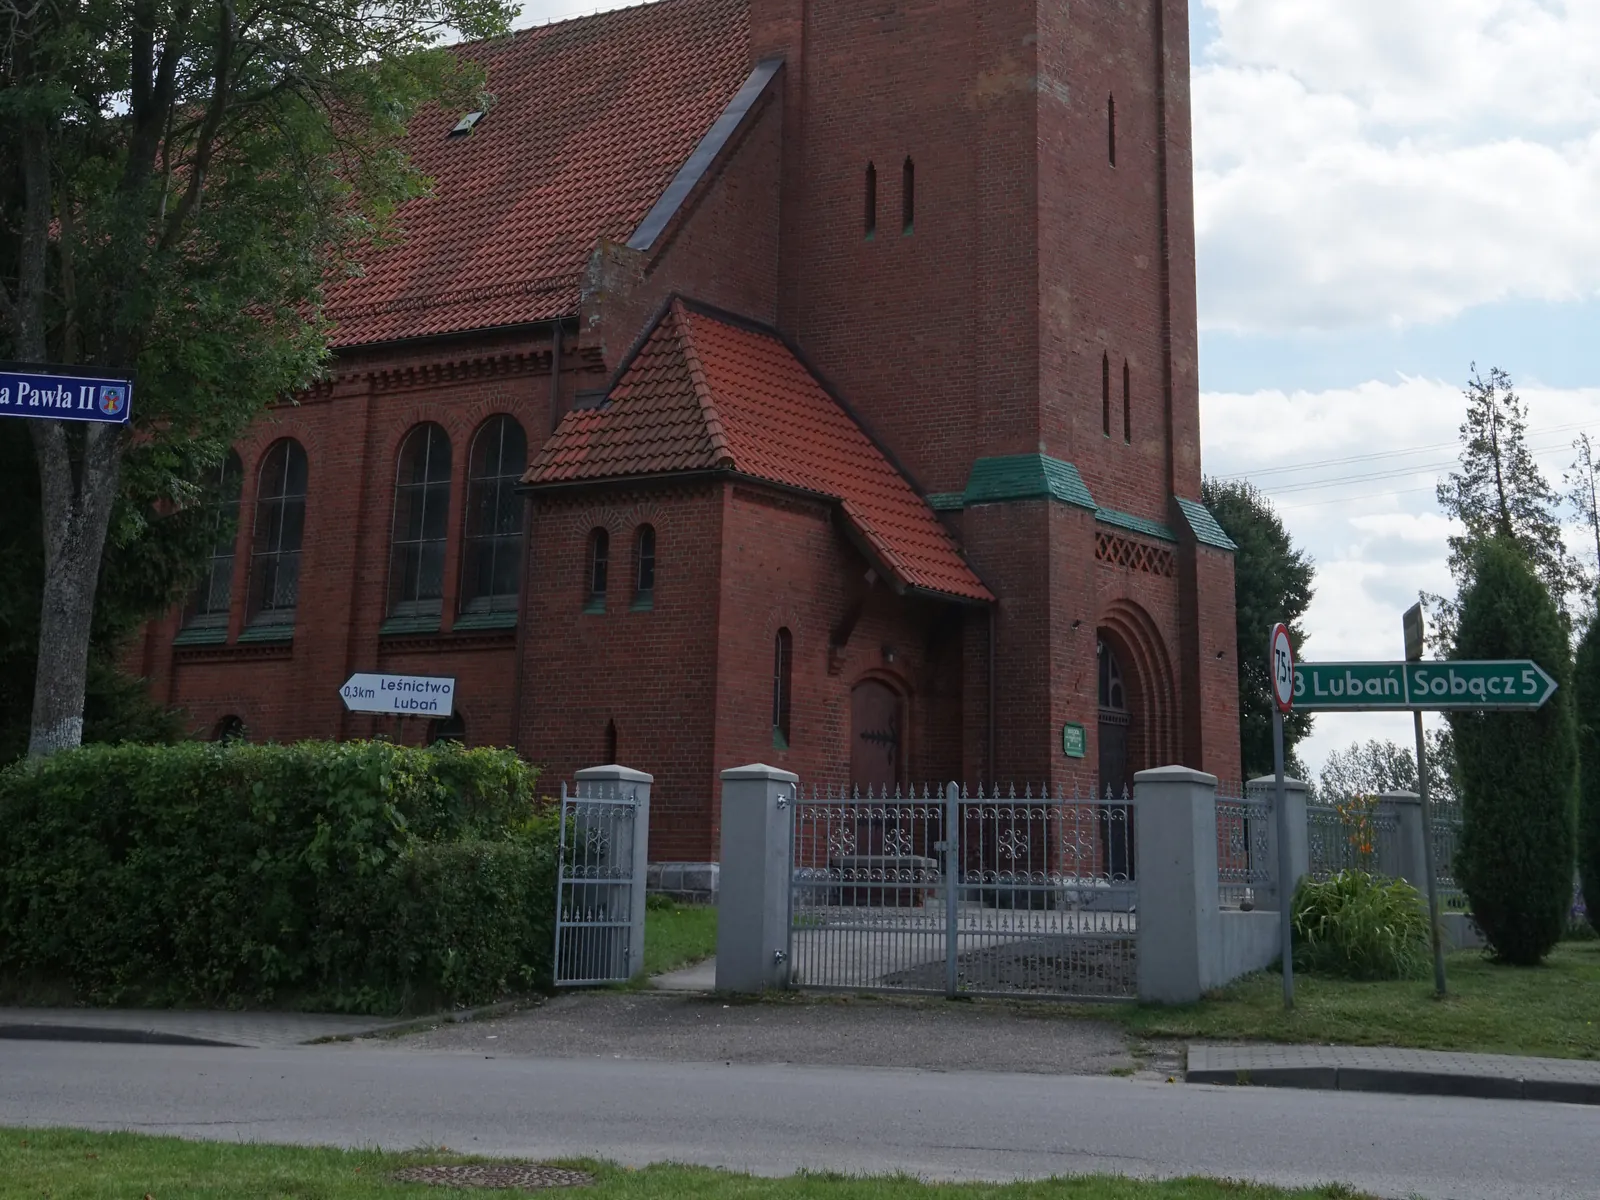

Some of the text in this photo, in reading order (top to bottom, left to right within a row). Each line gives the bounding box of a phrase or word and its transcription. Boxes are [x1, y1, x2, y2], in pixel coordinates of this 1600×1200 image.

[15, 382, 73, 409] Pawła
[77, 386, 96, 410] II
[381, 679, 451, 694] Leśnictwo
[1313, 669, 1399, 696] Lubań
[1413, 669, 1538, 702] Sobącz 5
[393, 696, 438, 711] Lubań
